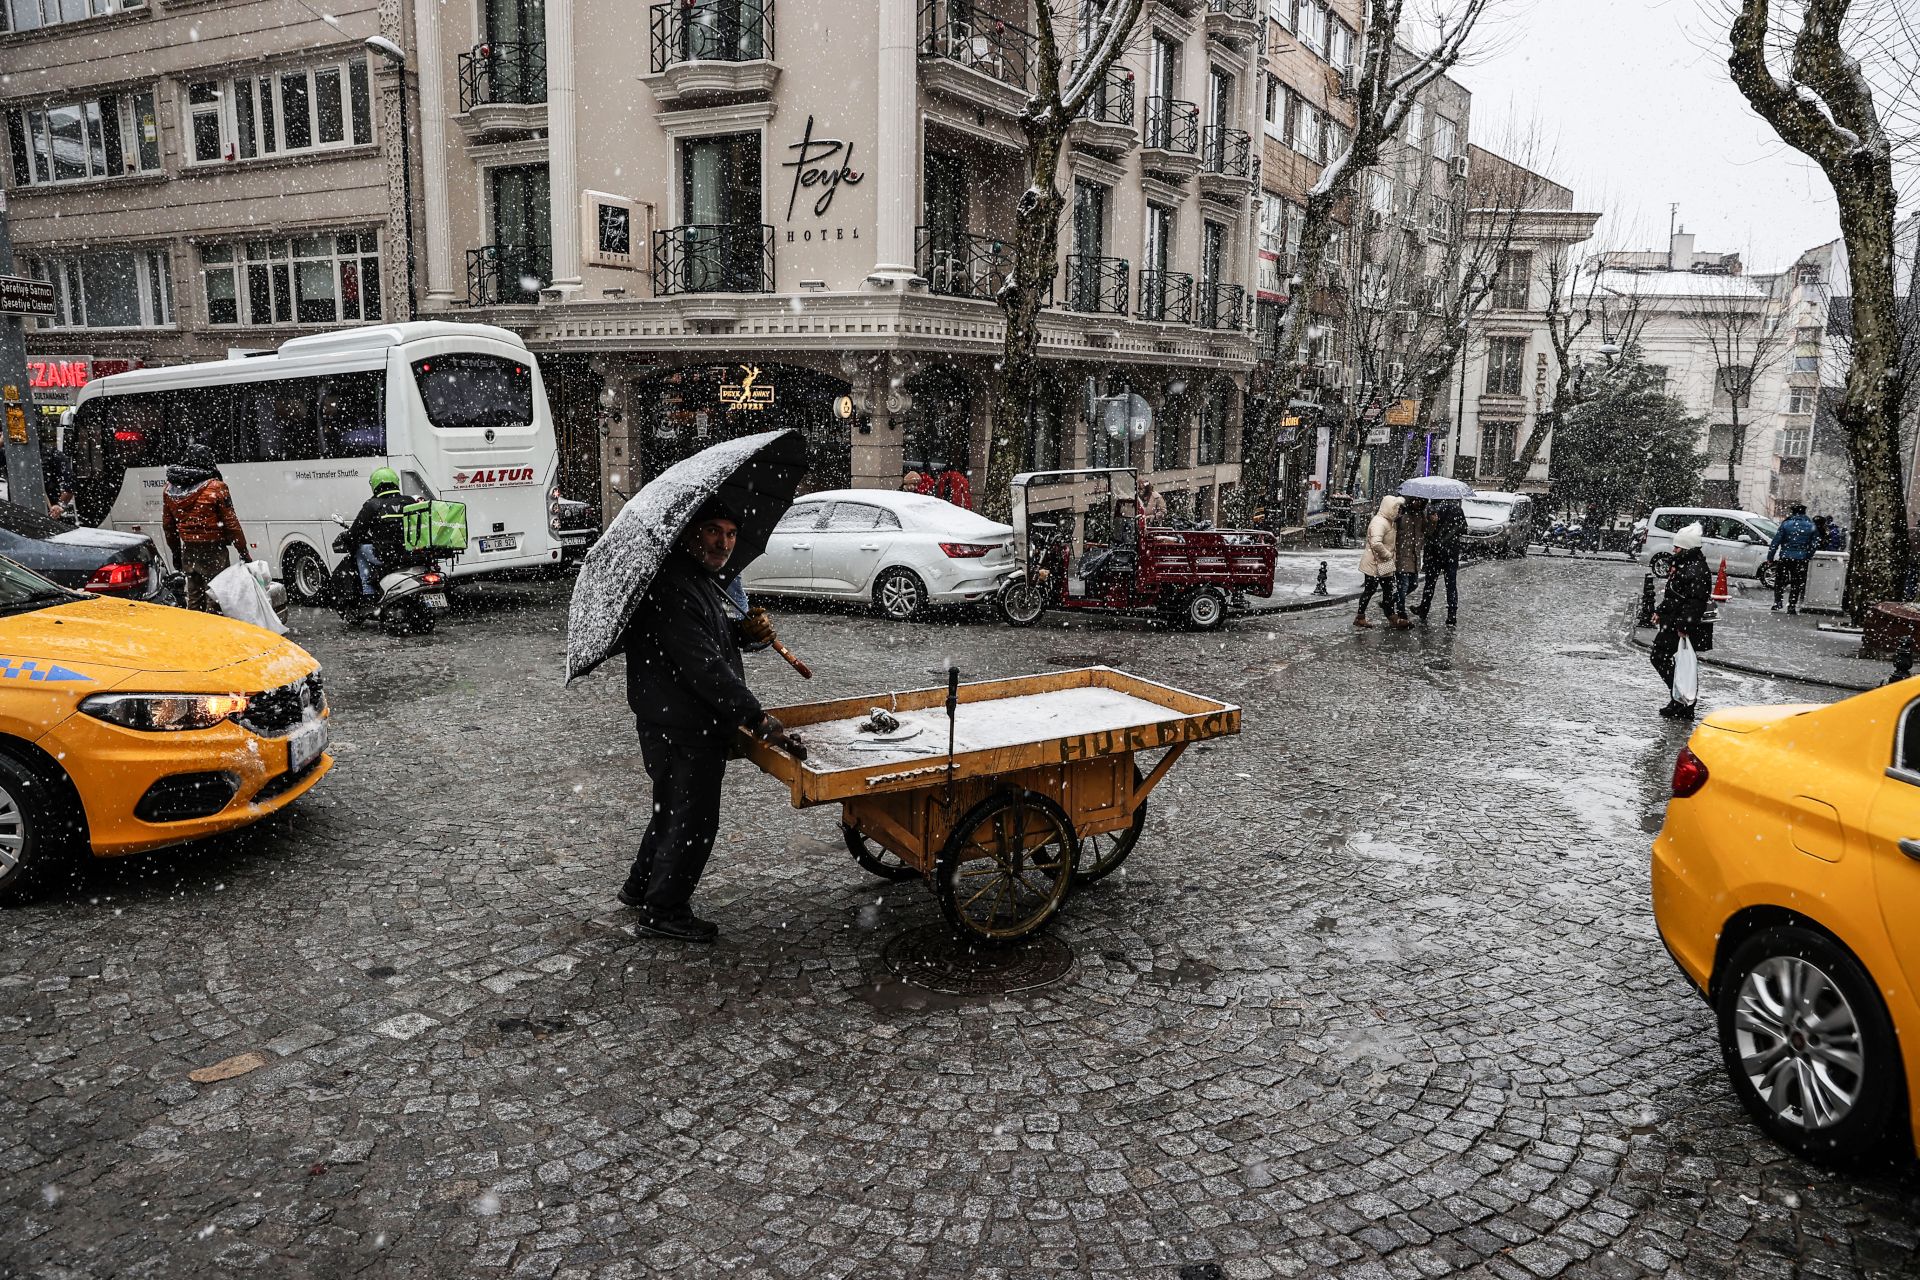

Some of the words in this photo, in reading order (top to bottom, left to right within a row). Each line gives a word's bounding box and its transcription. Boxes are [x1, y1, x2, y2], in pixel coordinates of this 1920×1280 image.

[782, 114, 864, 222] Peyk
[602, 207, 628, 248] Peyk
[787, 228, 859, 242] HOTEL
[599, 253, 631, 263] HOTEL
[450, 357, 499, 368] TEMSA
[722, 390, 741, 398] PEYK
[752, 390, 770, 398] AWAY
[730, 402, 764, 411] COFFEE
[295, 471, 312, 480] Hotel
[312, 470, 336, 480] Transfer
[337, 469, 359, 478] Shuttle
[470, 468, 534, 483] ALTUR
